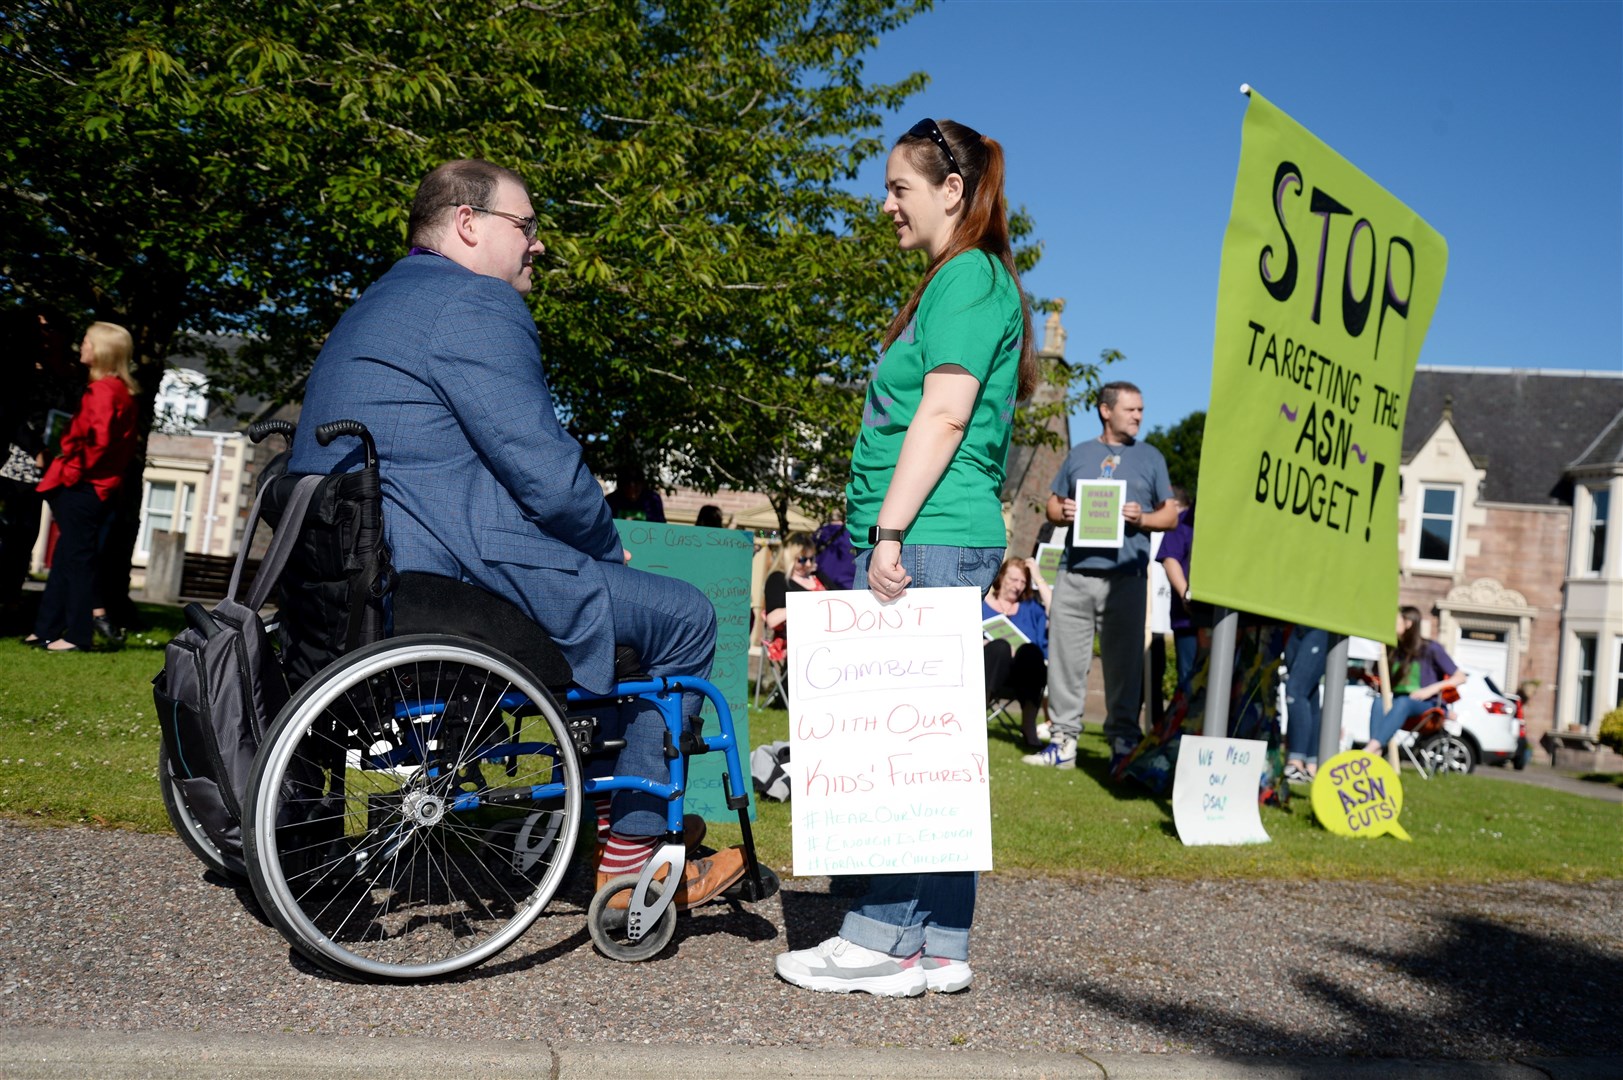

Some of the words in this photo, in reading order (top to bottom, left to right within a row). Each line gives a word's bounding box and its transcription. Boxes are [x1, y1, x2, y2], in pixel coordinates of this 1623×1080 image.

[1258, 160, 1415, 361] STOP
[1248, 320, 1362, 415] TARGETING
[1373, 383, 1400, 431] THE
[1294, 401, 1353, 471] ASN
[1255, 450, 1386, 543] BUDGET!
[629, 527, 657, 545] OF
[665, 528, 703, 548] CLASS
[817, 598, 935, 633] DON'T
[805, 646, 944, 690] GAMBLE
[797, 712, 878, 741] WITH
[886, 703, 963, 734] OUR
[806, 759, 875, 797] KIDS'
[887, 752, 987, 786] FUTURES!
[1198, 747, 1214, 767] WE
[1226, 745, 1251, 766] NEED
[1329, 756, 1372, 787] STOP
[1336, 776, 1387, 816] ASN
[1347, 794, 1398, 832] CUTS!
